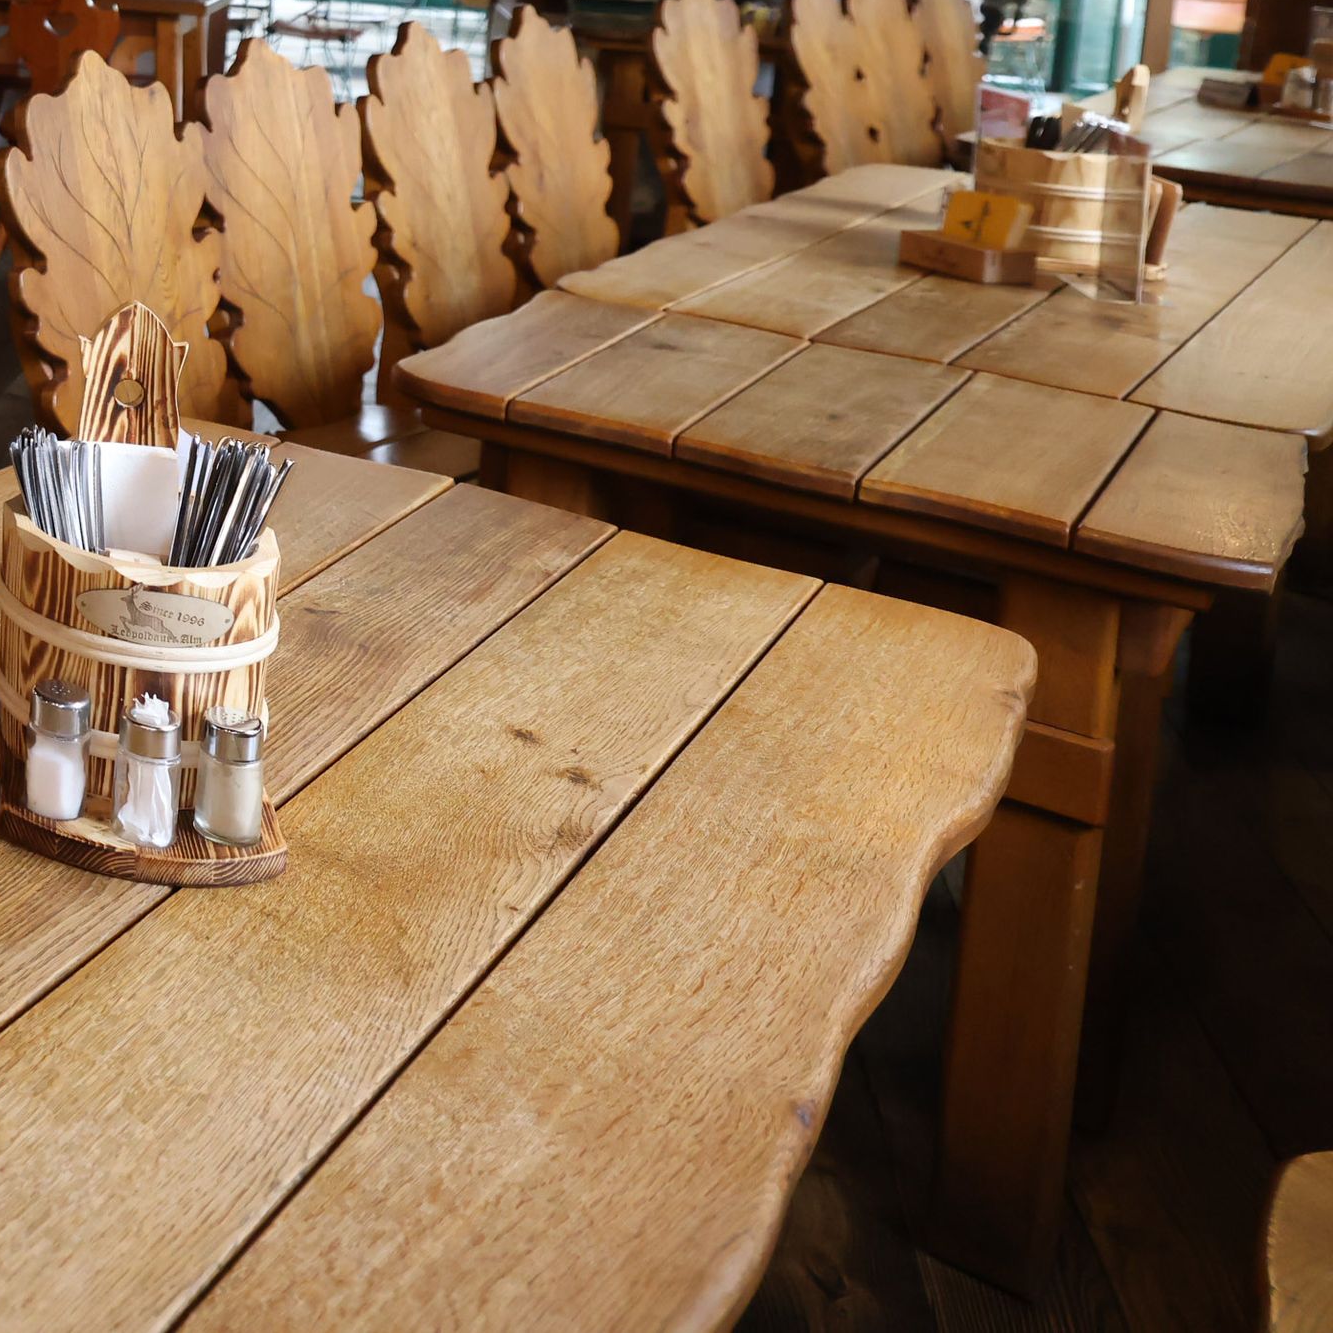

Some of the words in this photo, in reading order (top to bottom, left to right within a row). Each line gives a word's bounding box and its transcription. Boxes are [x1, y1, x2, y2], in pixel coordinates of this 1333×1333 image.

[139, 600, 174, 620] Since
[177, 611, 205, 627] 1996
[109, 624, 179, 644] Leopoldauer
[180, 632, 203, 645] Alm
